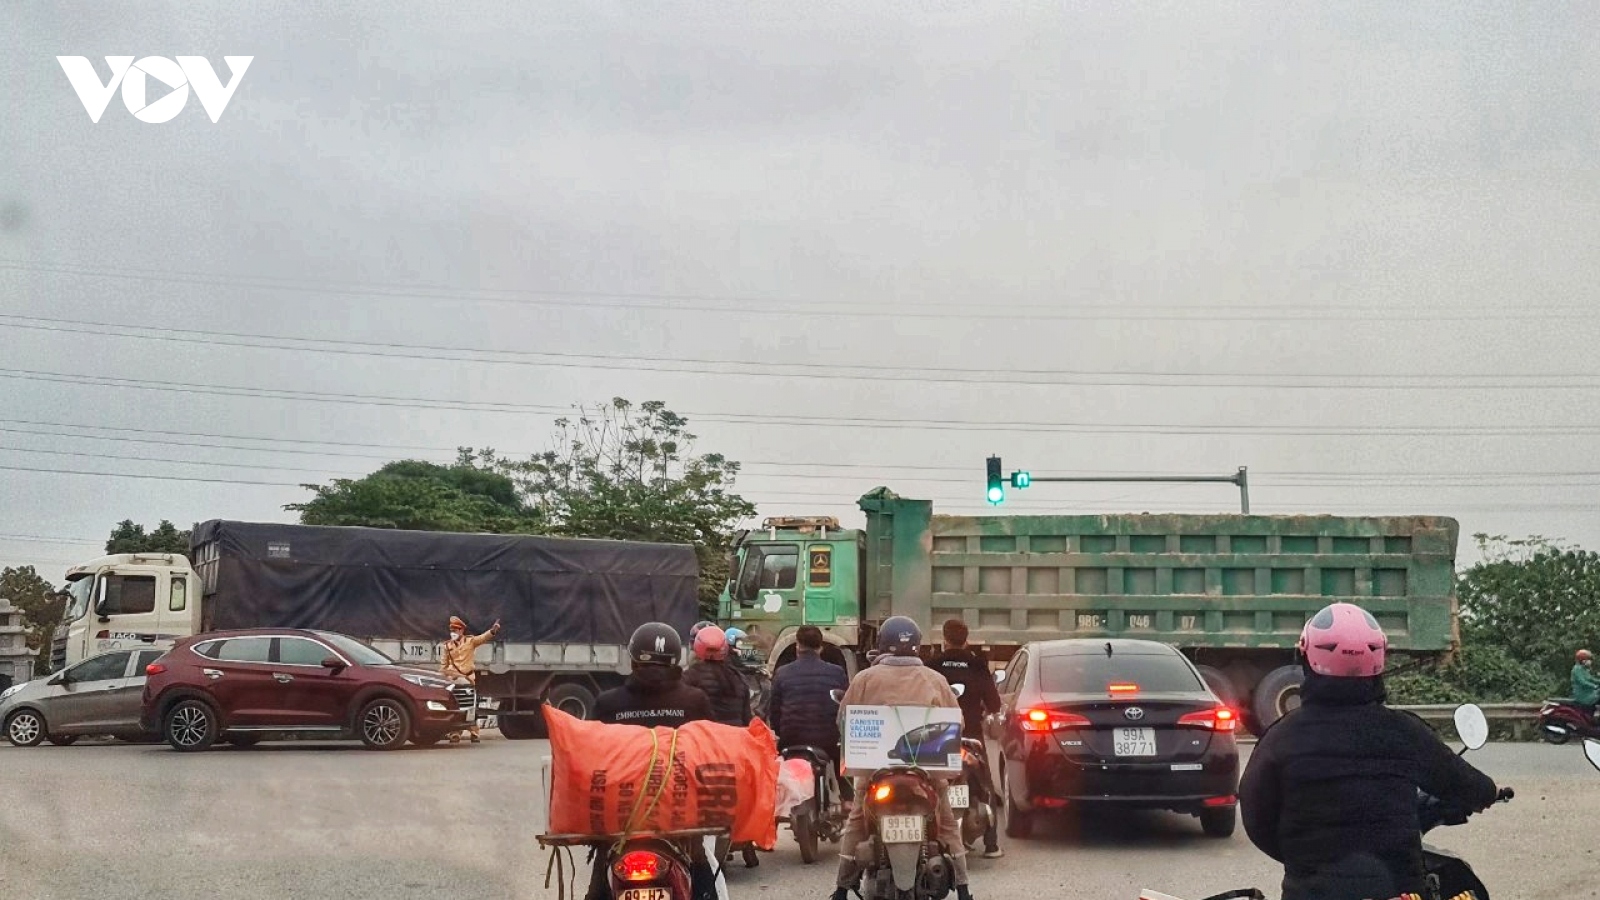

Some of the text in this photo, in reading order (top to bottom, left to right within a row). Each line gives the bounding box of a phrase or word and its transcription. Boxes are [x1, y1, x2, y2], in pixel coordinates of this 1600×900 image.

[850, 718, 885, 726] CANISTER
[850, 731, 882, 739] CLEANER
[1123, 728, 1146, 741] 99A
[1115, 741, 1154, 755] 387.71
